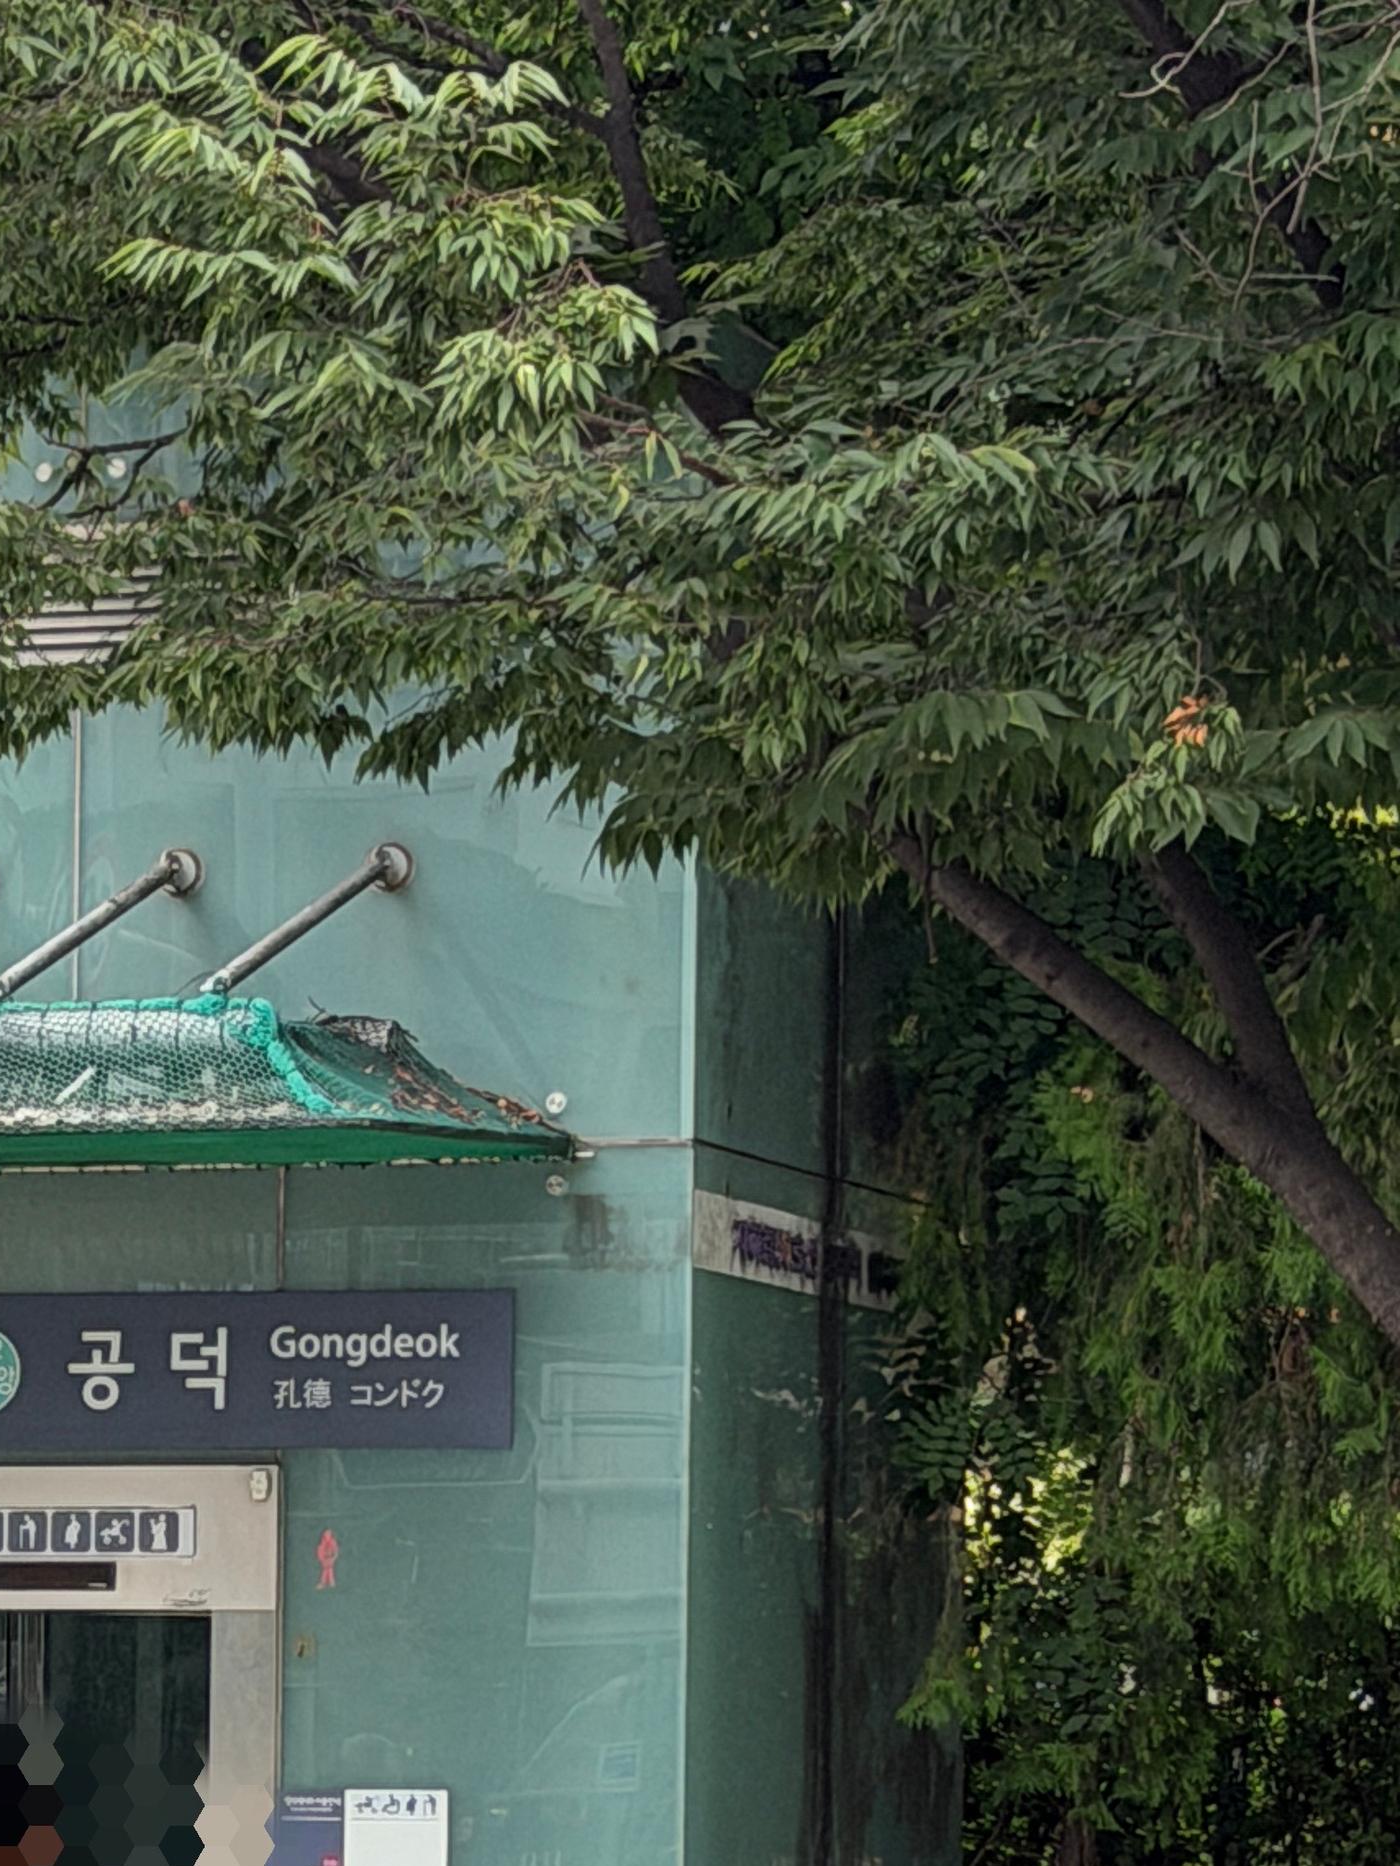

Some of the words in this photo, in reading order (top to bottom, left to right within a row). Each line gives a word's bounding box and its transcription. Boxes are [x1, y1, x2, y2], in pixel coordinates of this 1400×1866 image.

[270, 1323, 461, 1367] Gongdeok
[350, 1378, 445, 1409] コンドク
